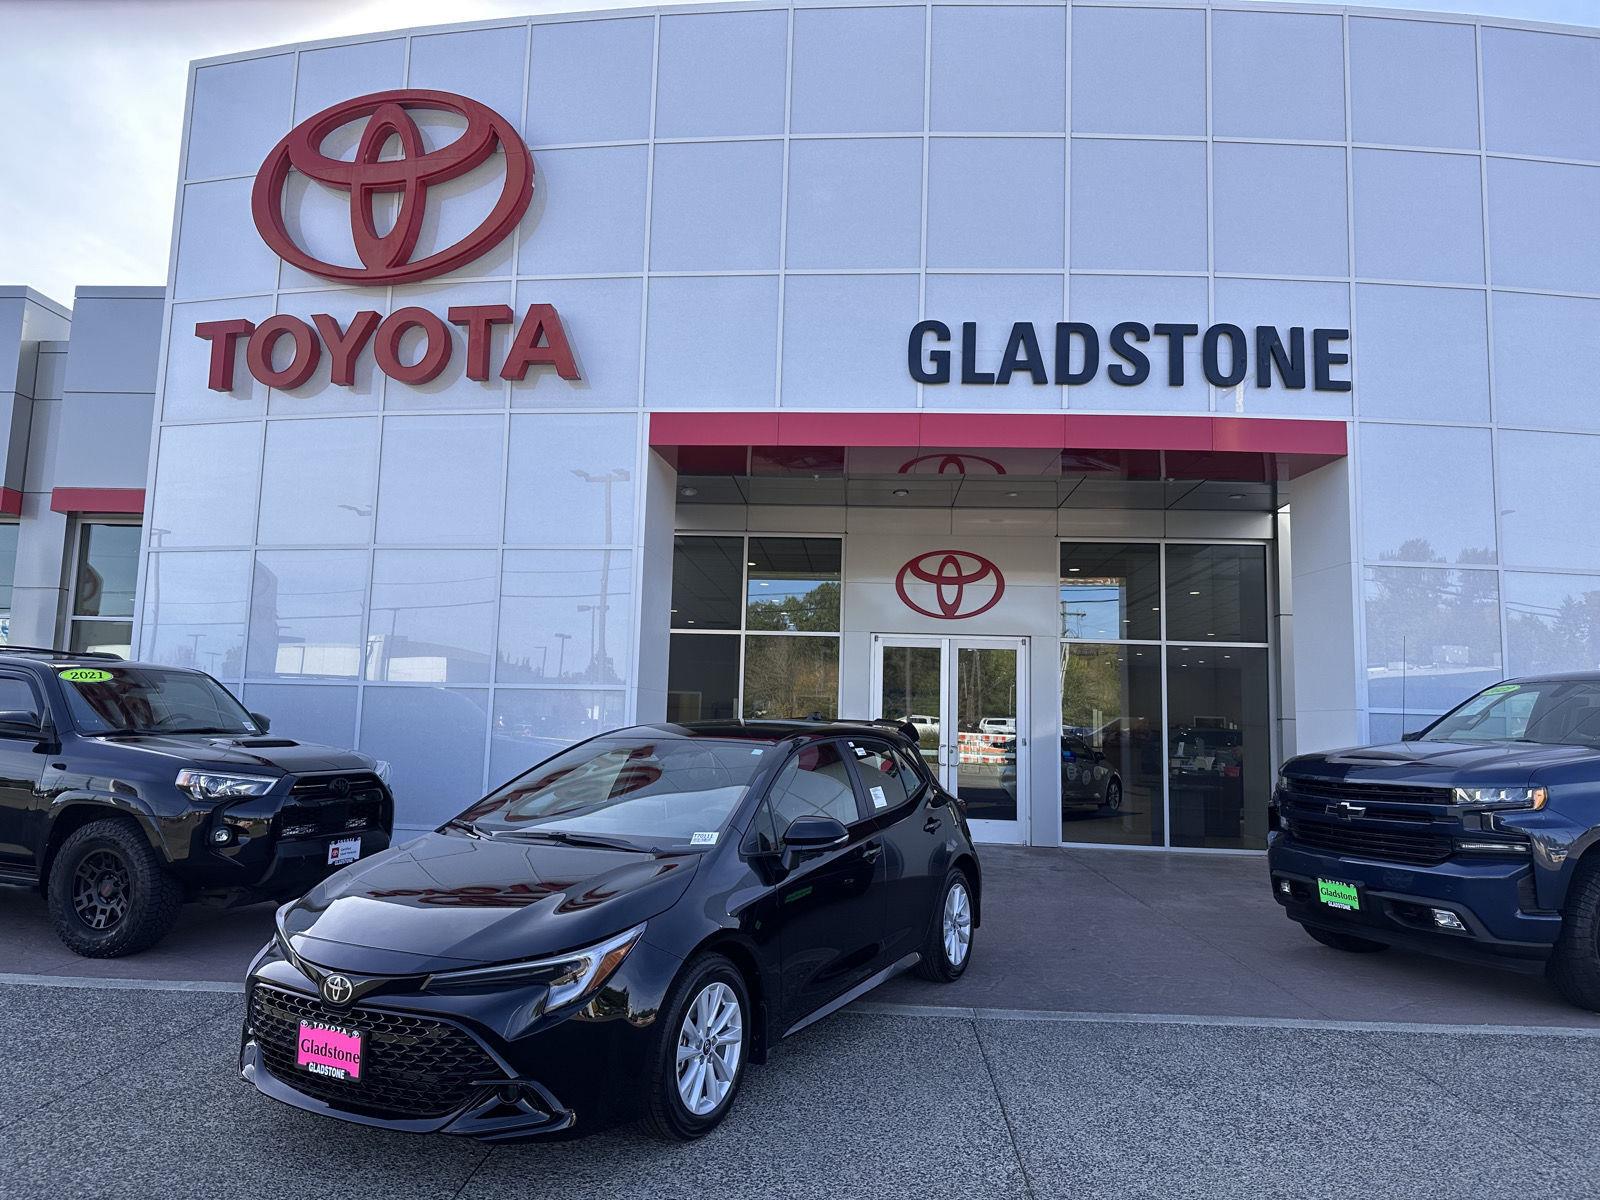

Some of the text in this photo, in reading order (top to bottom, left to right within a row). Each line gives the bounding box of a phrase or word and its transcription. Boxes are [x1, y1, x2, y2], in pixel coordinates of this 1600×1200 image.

[195, 303, 582, 393] TOYOTA
[908, 319, 1352, 392] GLADSTONE
[70, 671, 103, 680] 2021
[1320, 887, 1357, 902] Gladstone
[313, 1022, 347, 1035] TOYOTA
[301, 1038, 360, 1064] Gladstone
[308, 1063, 345, 1079] GLADSTONE
